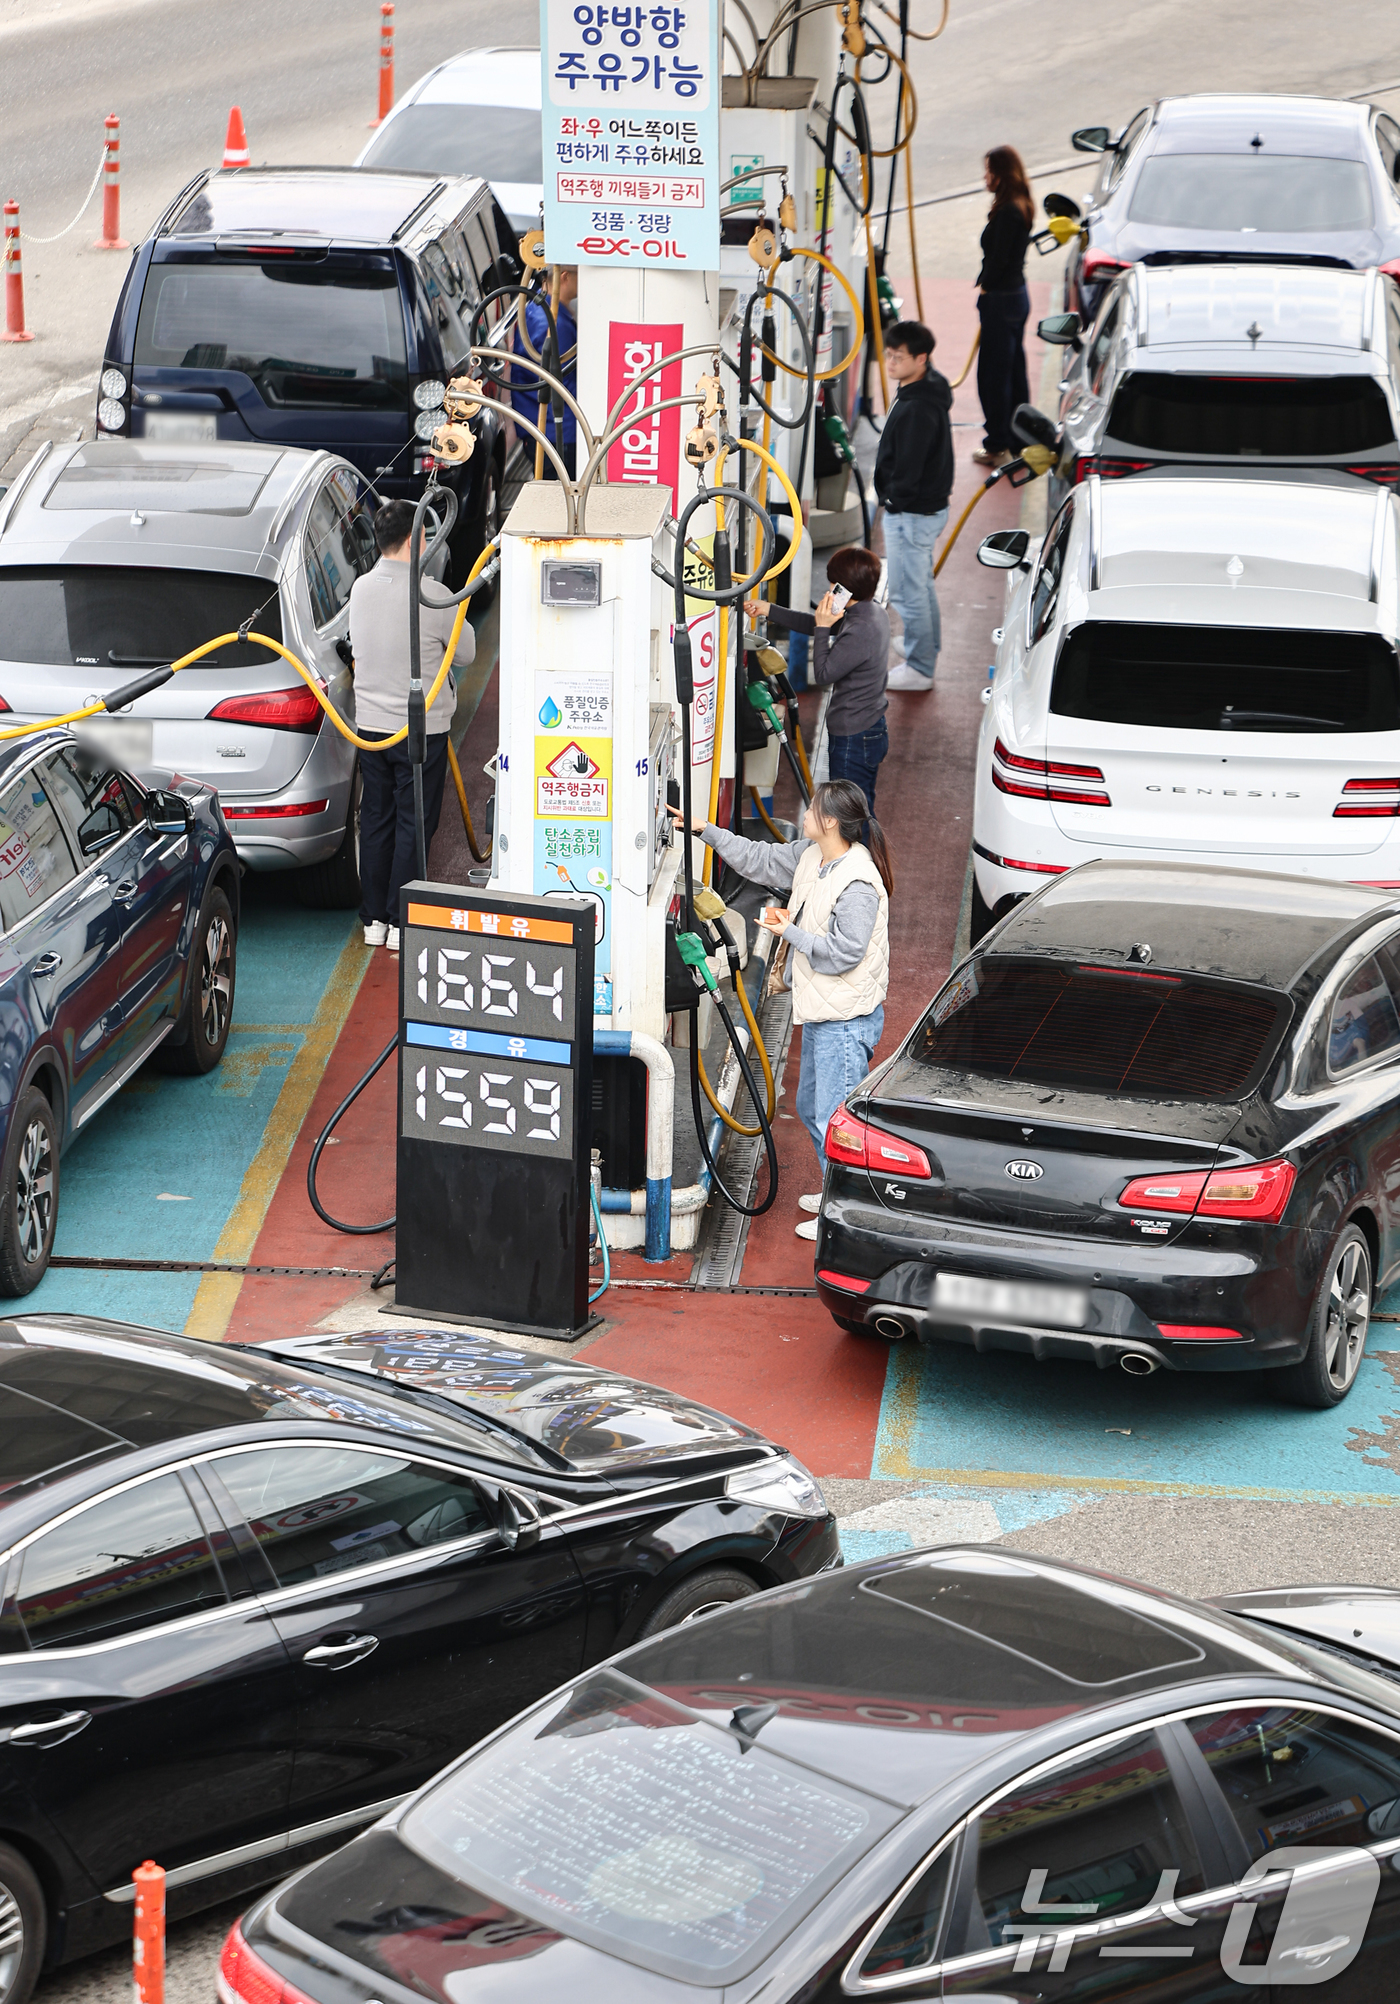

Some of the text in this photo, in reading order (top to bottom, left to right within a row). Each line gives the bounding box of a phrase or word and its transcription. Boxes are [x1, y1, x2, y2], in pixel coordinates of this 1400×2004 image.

[573, 5, 686, 48] 양방향
[555, 53, 703, 97] 주유가능
[561, 118, 699, 143] 좌·우 어느쪽이든
[556, 142, 704, 166] 편하게 주유하세요
[561, 179, 700, 201] 역주행 끼워들기 금지
[563, 695, 610, 710] 품질인증
[569, 711, 604, 723] 주유소
[498, 753, 510, 772] 14
[635, 758, 649, 777] 15
[541, 782, 604, 797] 역주행금지
[1145, 784, 1301, 798] GENESIS
[544, 827, 601, 843] 탄소중립
[545, 843, 601, 857] 실천하기
[417, 947, 564, 1022] 1664
[416, 1065, 561, 1141] 1559
[1010, 1163, 1037, 1178] KIA
[885, 1183, 907, 1200] K3
